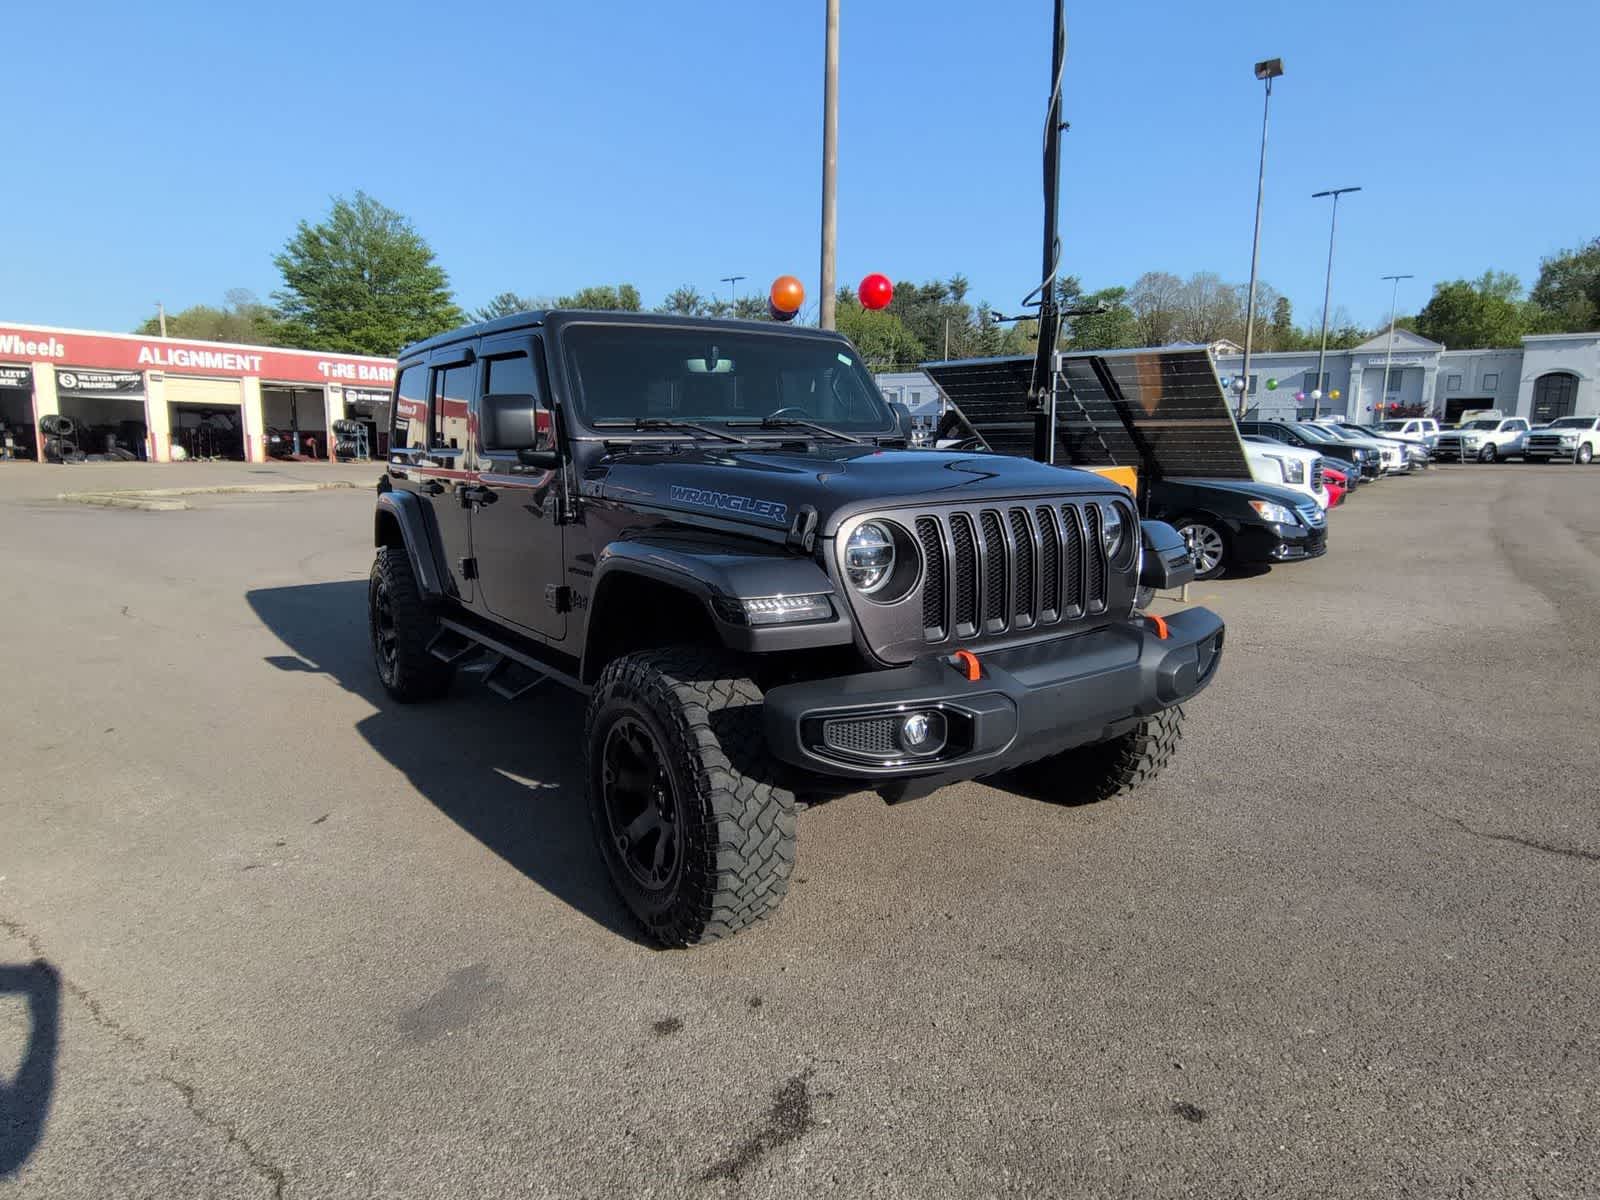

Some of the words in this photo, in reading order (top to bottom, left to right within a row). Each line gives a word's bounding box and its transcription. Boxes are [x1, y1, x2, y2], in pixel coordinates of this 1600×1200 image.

[0, 335, 65, 357] Wheels
[138, 346, 263, 371] ALIGNMENT
[671, 485, 788, 523] WRANGLER
